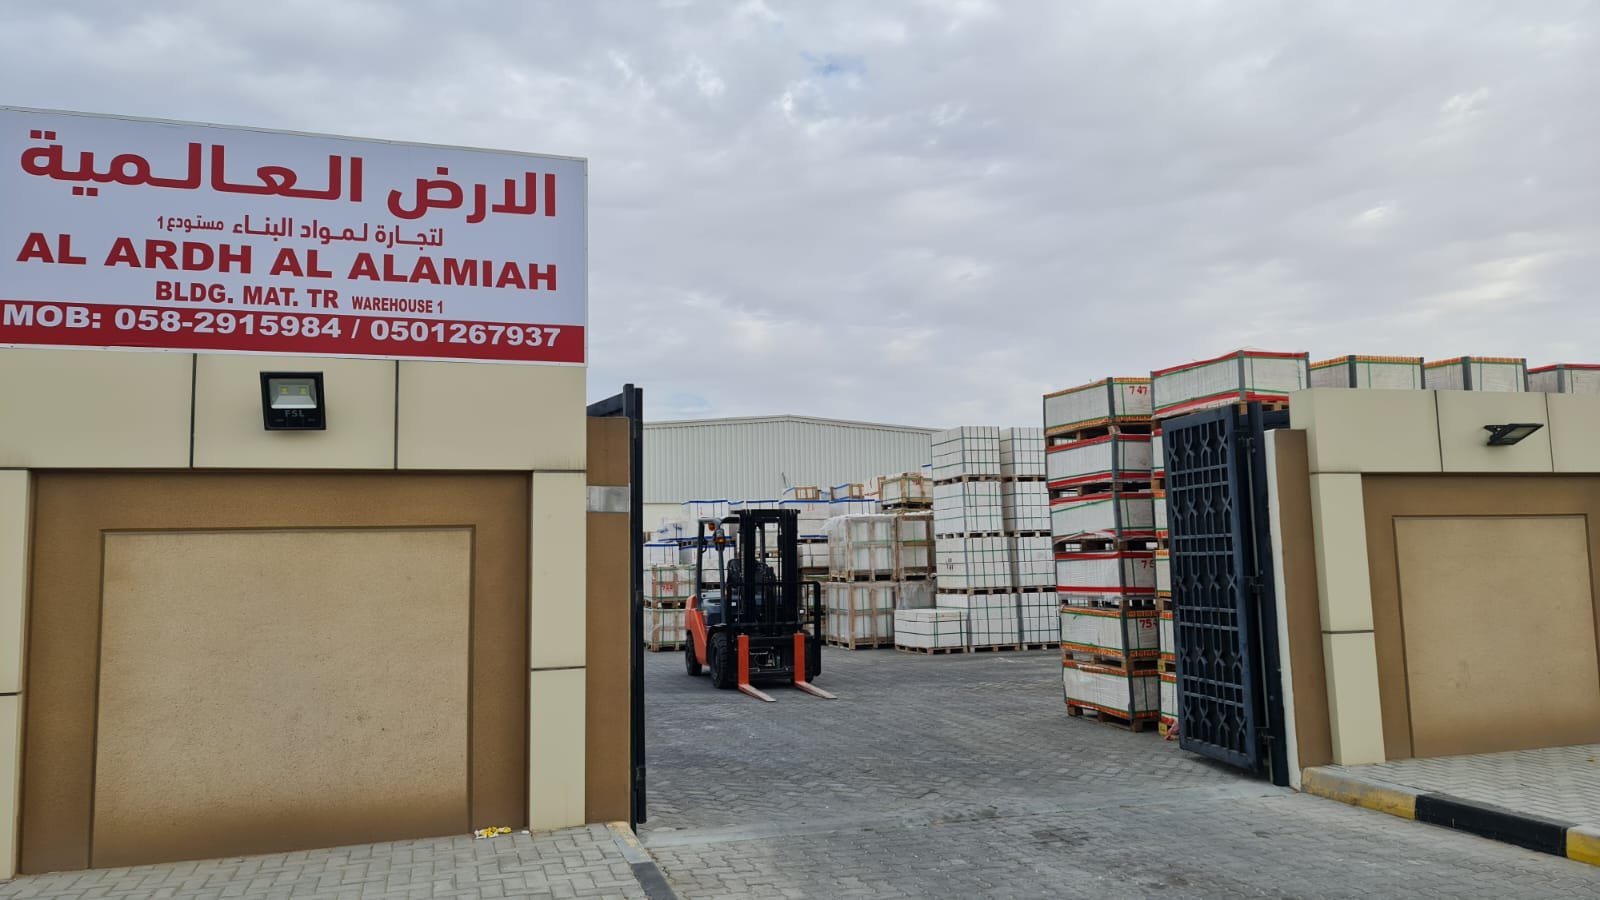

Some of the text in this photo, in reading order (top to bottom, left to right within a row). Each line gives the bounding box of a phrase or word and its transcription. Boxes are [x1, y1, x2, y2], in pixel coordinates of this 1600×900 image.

[20, 129, 556, 224] الارض العالمية
[232, 214, 293, 242] البناء
[300, 219, 368, 245] لمواد
[374, 224, 444, 250] لتجارة
[16, 232, 557, 291] AL ARDH AL ALAMIAH
[155, 280, 444, 315] BLDG. MAT. TR WAREHOUSE 1
[2, 303, 561, 347] MOB: 058-2915984 / 0501267937
[284, 409, 305, 418] FSL
